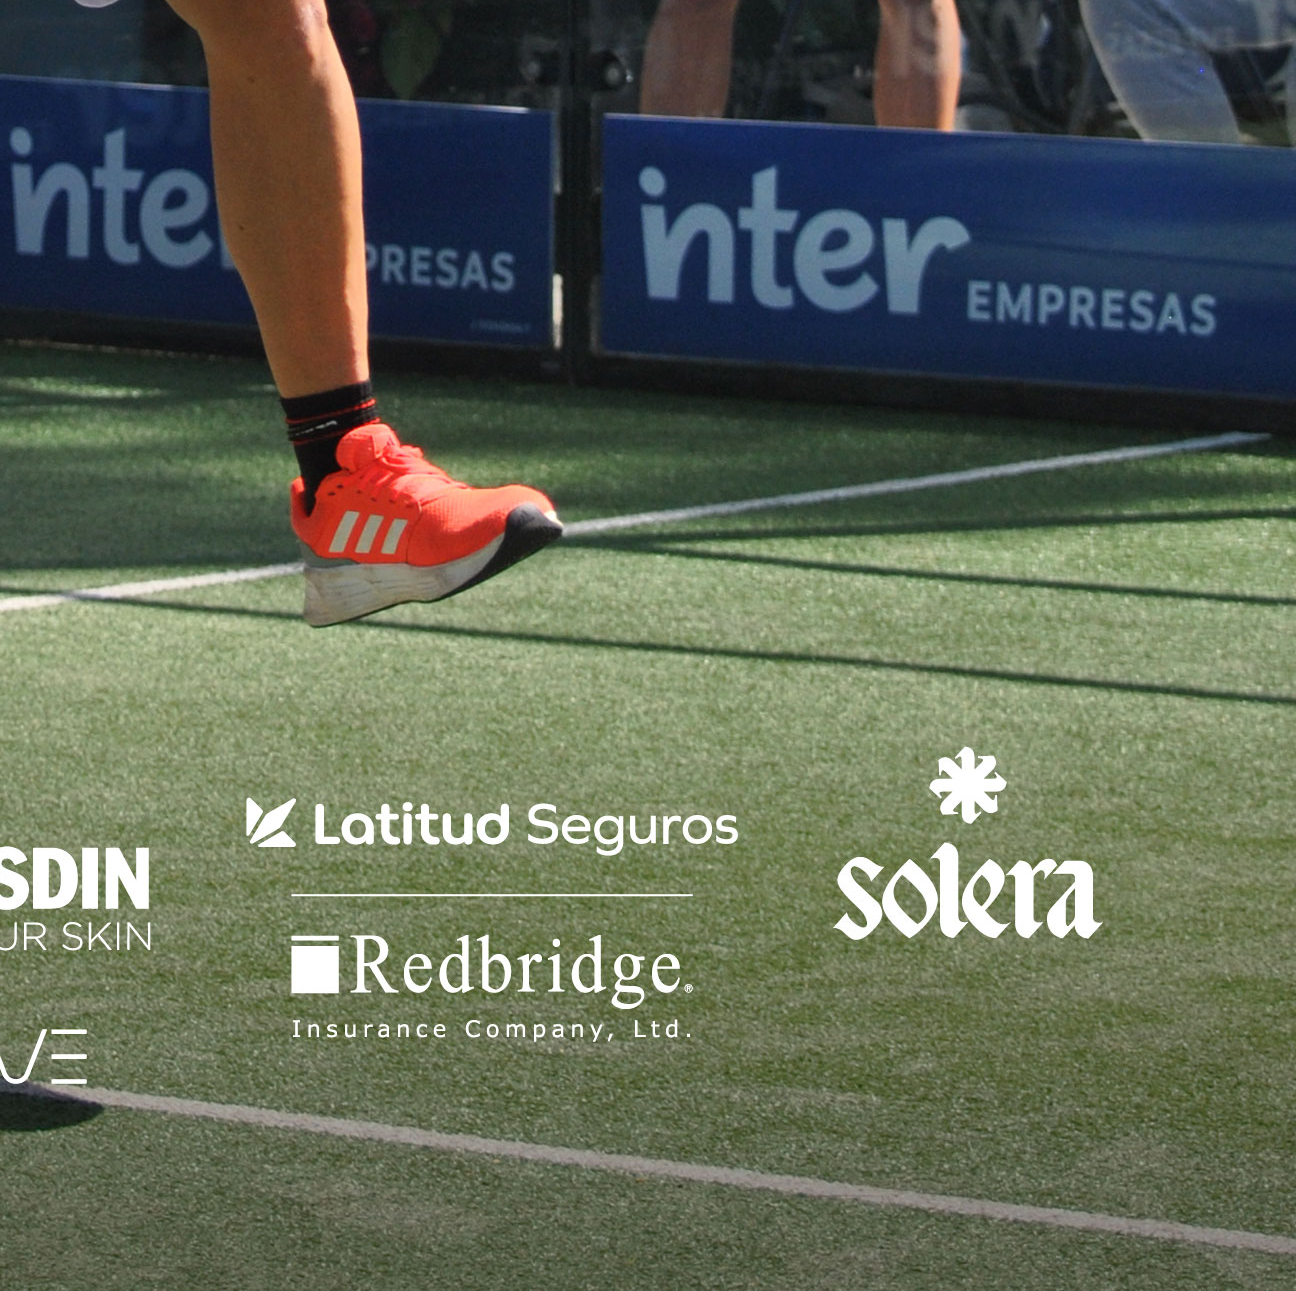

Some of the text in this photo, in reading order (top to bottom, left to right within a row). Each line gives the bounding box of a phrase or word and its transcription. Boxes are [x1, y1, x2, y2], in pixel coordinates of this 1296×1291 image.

[9, 128, 235, 269] inte
[638, 166, 1217, 337] inter EMPRESAS
